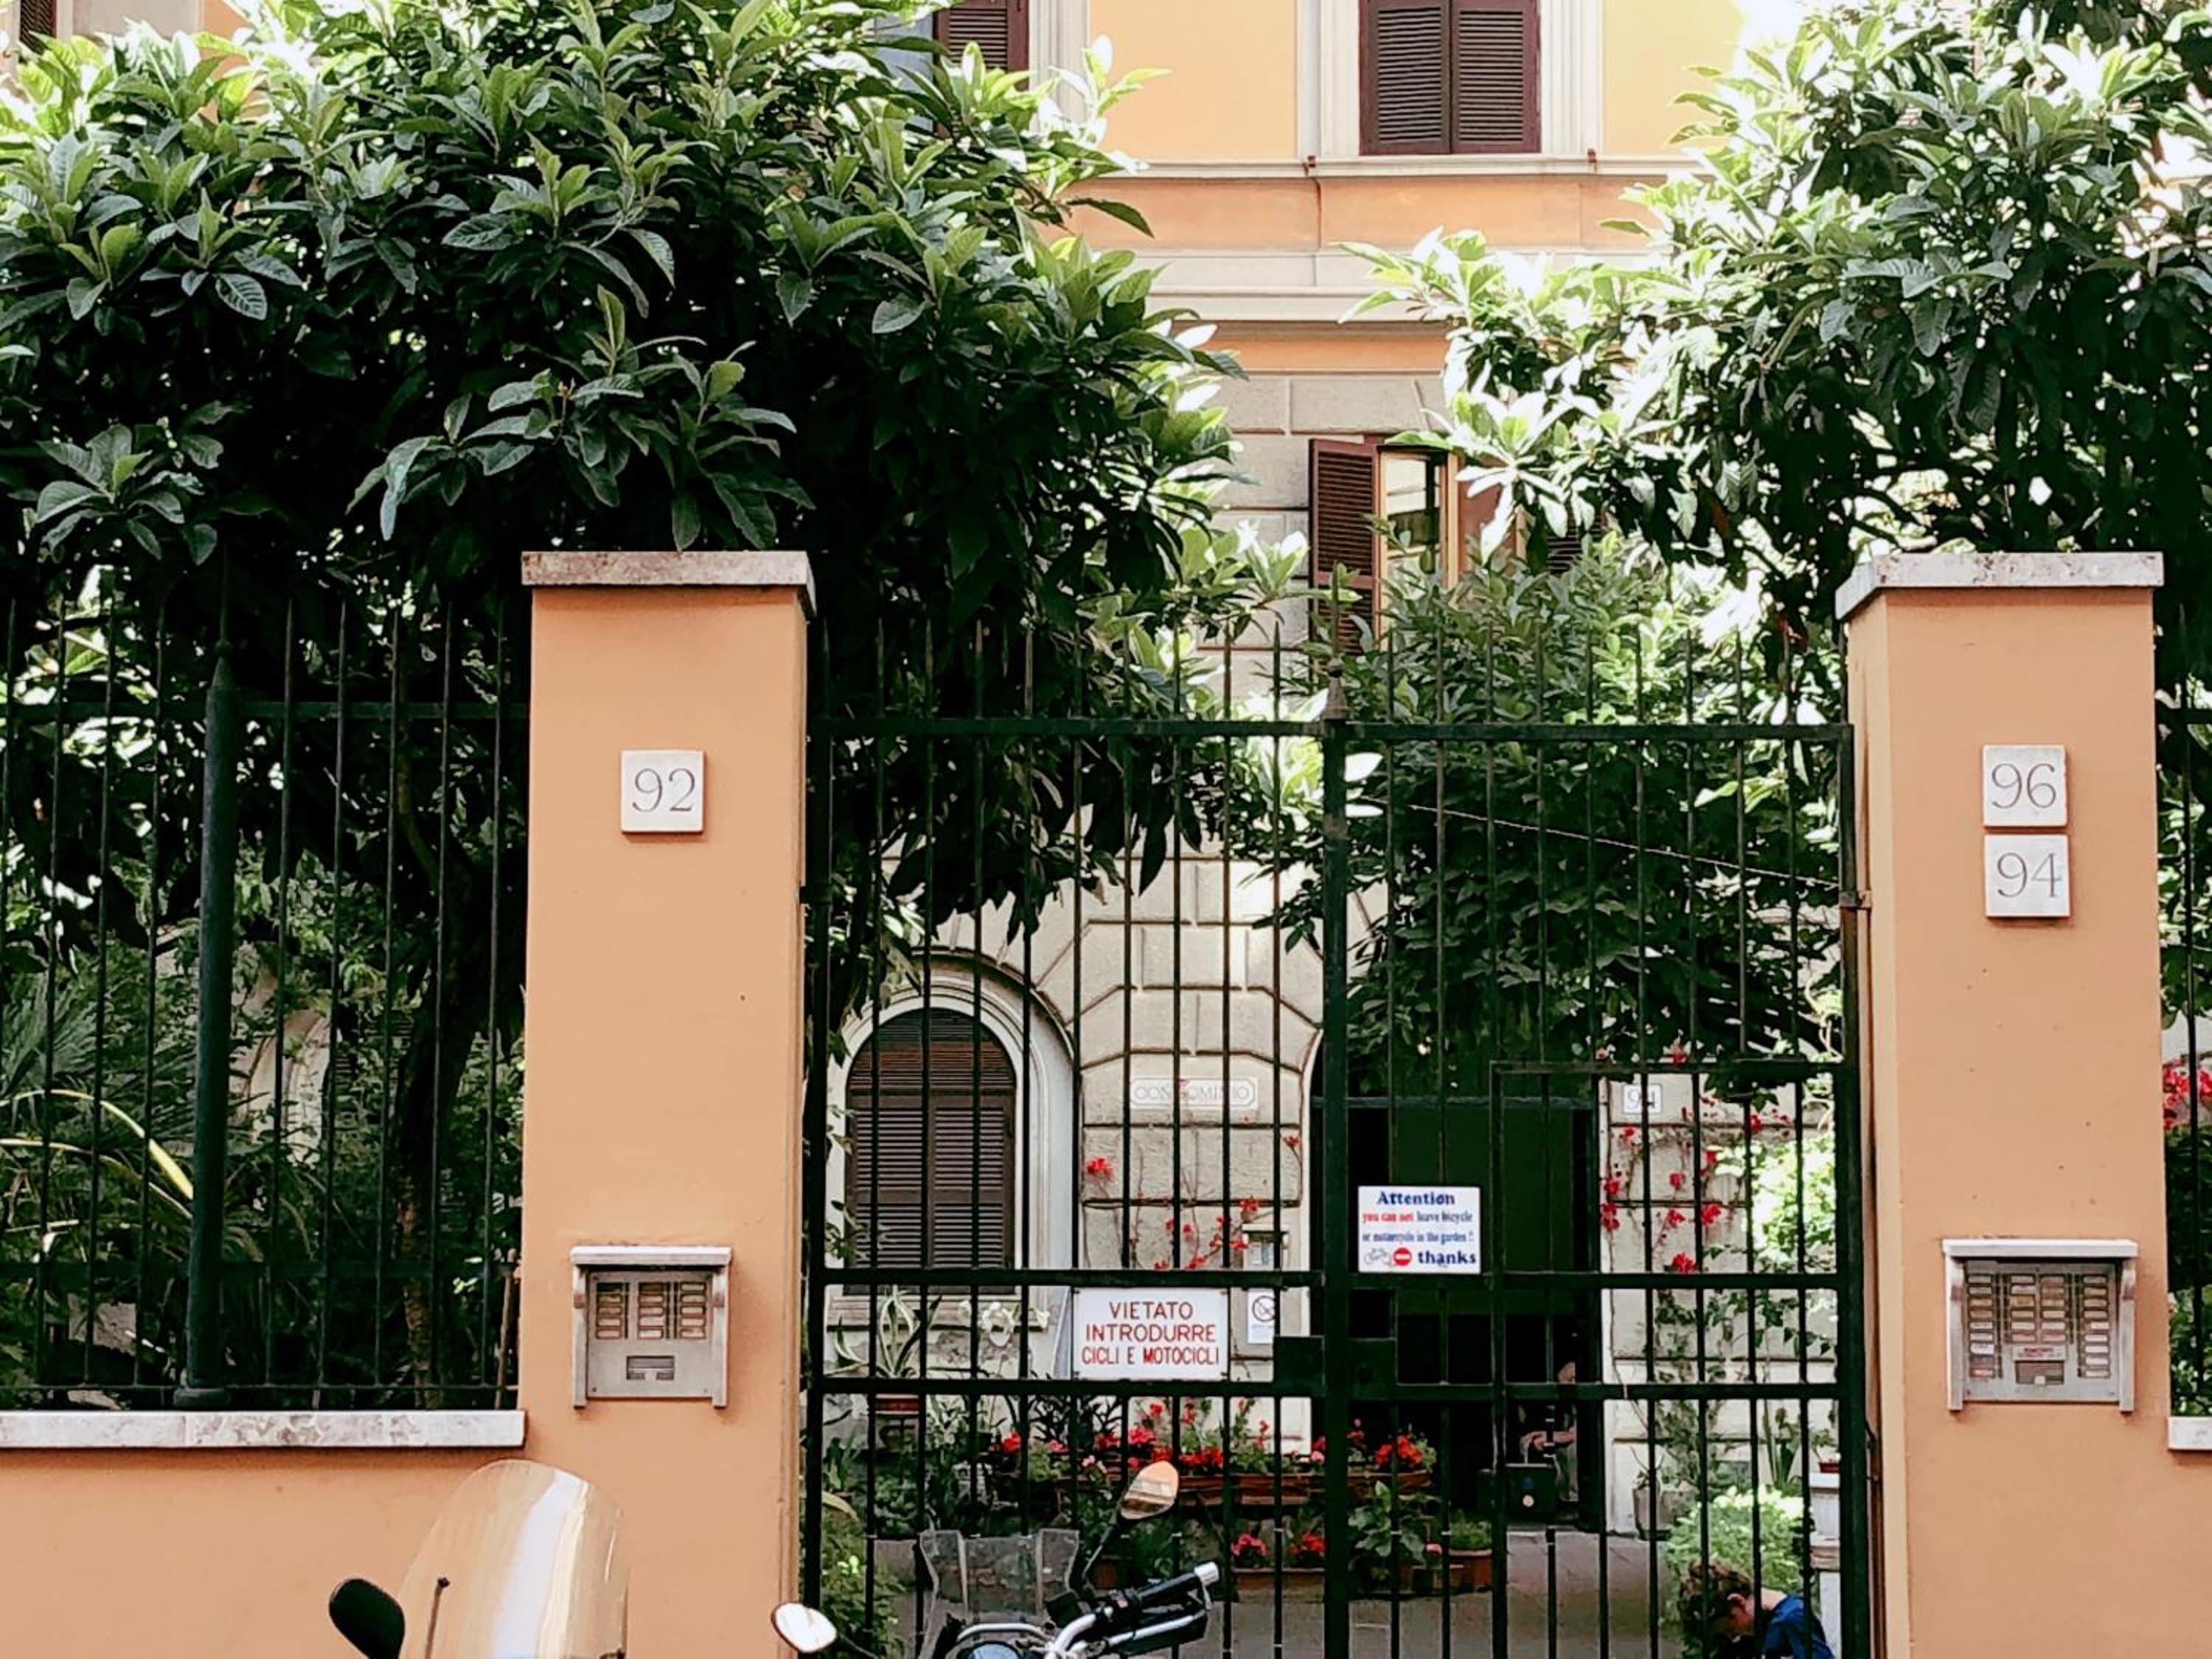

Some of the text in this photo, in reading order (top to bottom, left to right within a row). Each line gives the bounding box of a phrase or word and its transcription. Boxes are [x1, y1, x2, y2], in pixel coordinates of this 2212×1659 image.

[632, 768, 695, 812] 92
[1992, 763, 2056, 809] 96
[1997, 852, 2062, 898] 94
[1377, 1191, 1455, 1205] Attention
[1362, 1213, 1379, 1225] you
[1381, 1213, 1397, 1222] can
[1442, 1211, 1472, 1224] bicycle
[1363, 1234, 1371, 1242] or
[1427, 1232, 1439, 1242] the
[1418, 1251, 1476, 1265] thanks
[1109, 1301, 1193, 1320] VIETATO
[1086, 1324, 1216, 1342] INTRODURRE
[1082, 1347, 1219, 1364] CICLI E MOTOCICLI
